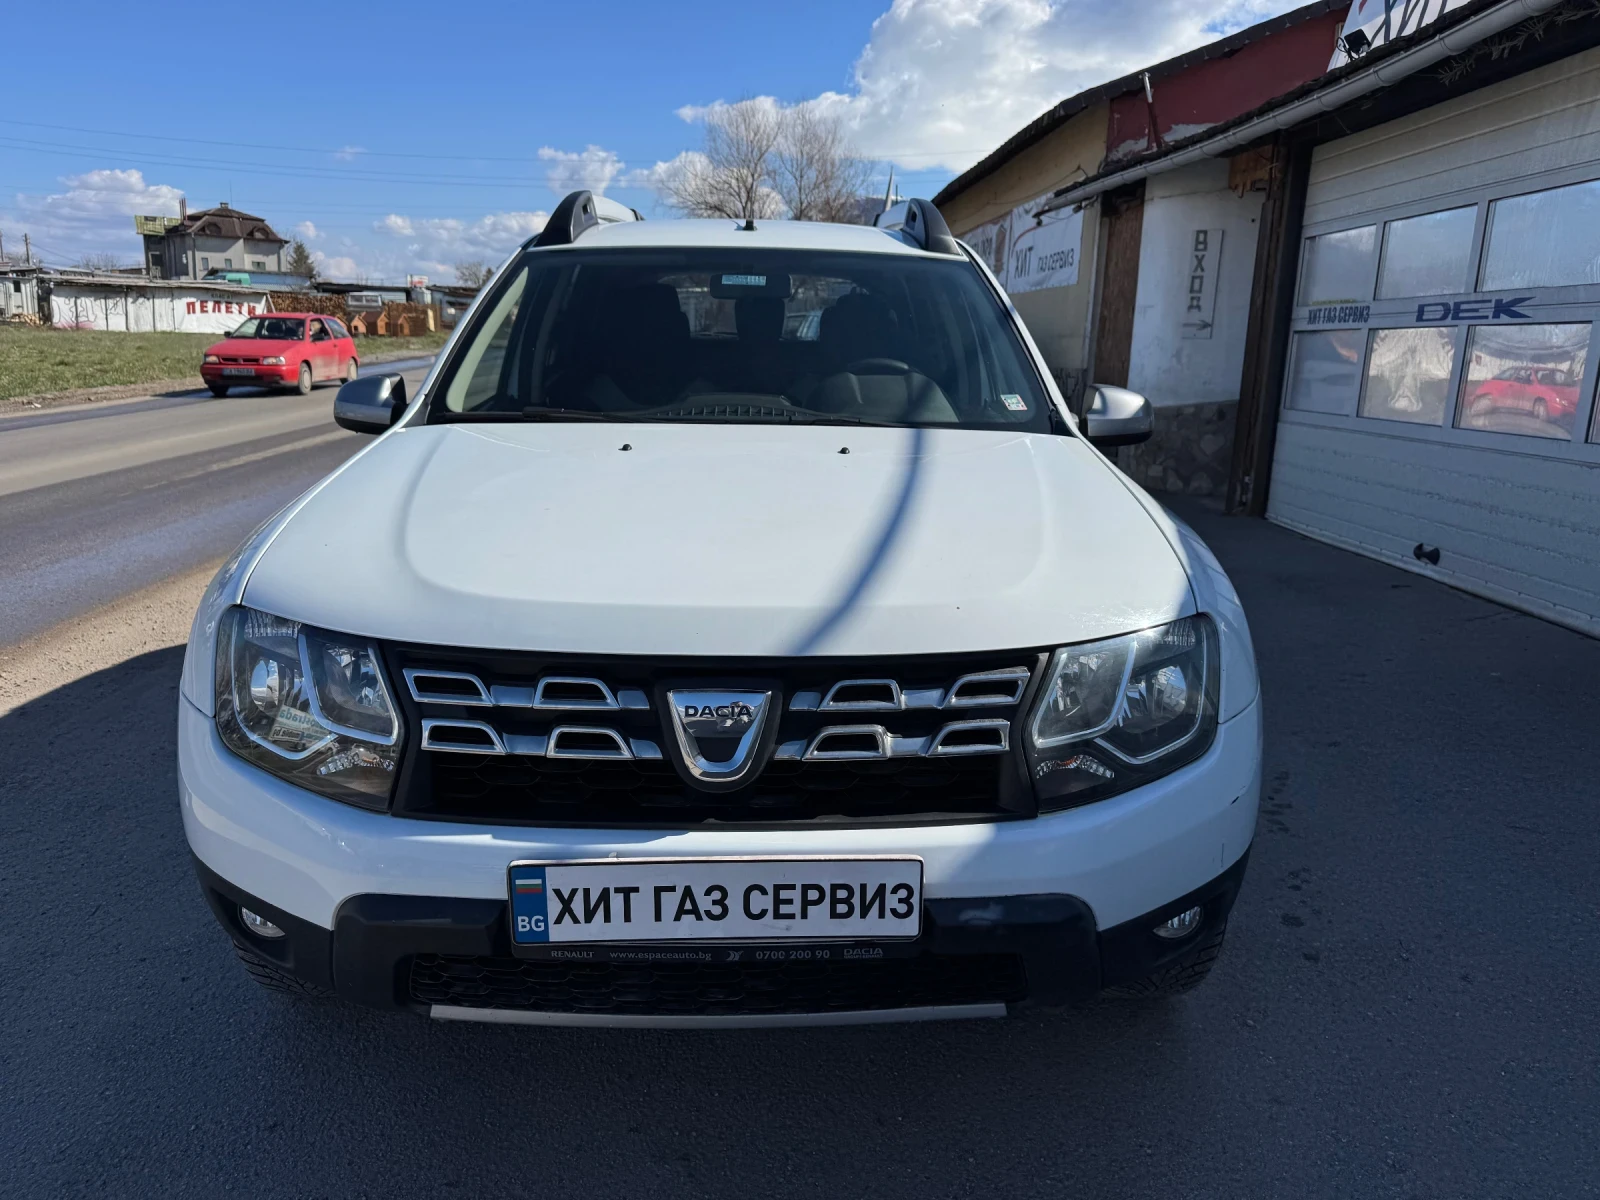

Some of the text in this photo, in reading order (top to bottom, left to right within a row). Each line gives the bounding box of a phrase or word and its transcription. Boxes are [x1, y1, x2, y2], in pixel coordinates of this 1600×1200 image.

[1014, 245, 1034, 280] ХИТ
[1047, 247, 1075, 272] СЕРВИЗ
[1187, 229, 1208, 313] ВХОД
[186, 300, 257, 317] ПЕЛЕТИ
[1307, 305, 1371, 325] ХИТ ГАЗ СЕРВИЗ
[1415, 296, 1537, 323] DEK
[684, 705, 753, 718] DACIA
[552, 882, 915, 926] ХИТ ГАЗ СЕРВИЗ
[517, 916, 546, 932] BG
[550, 950, 595, 959] RENAULT
[609, 950, 712, 961] www.espaceauto.bg
[789, 950, 812, 959] 200
[815, 949, 830, 959] 90
[843, 947, 884, 955] DACIA
